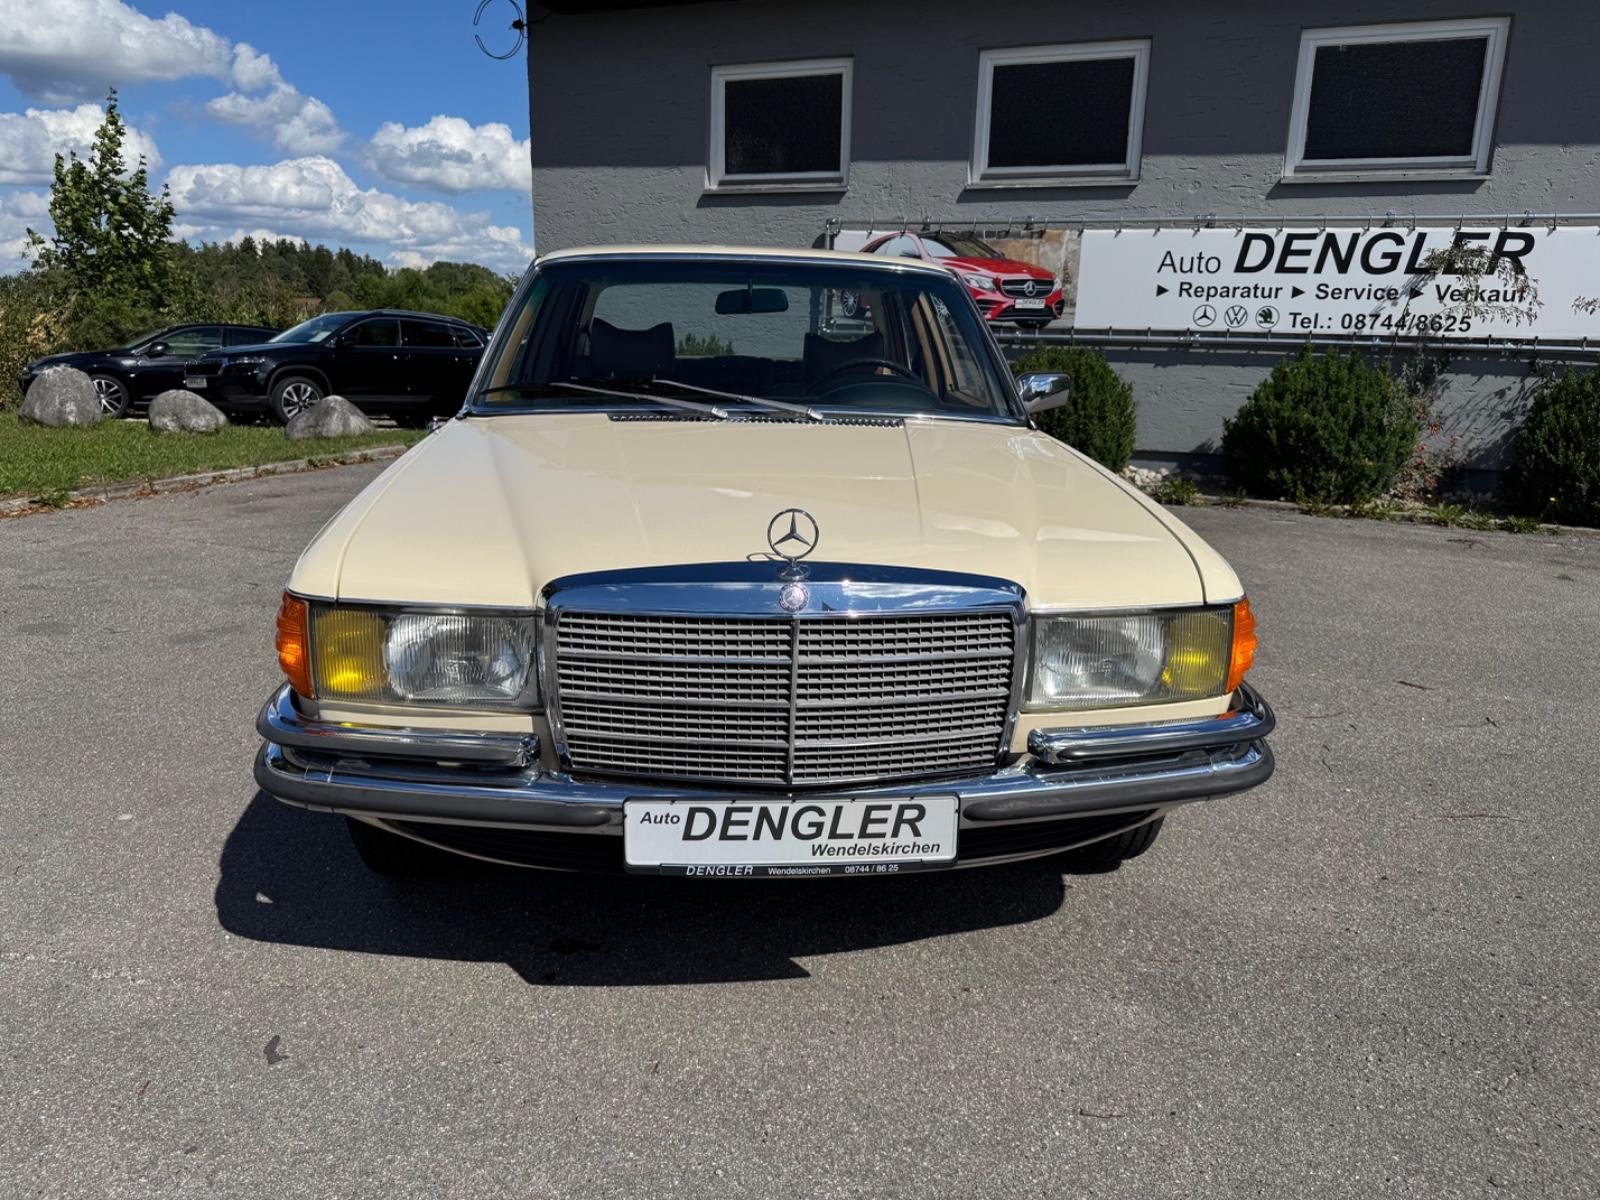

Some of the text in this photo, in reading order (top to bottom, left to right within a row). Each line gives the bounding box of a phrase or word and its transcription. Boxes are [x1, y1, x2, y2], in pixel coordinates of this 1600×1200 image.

[1156, 231, 1536, 276] Auto DENGLER
[1178, 281, 1284, 302] Reparatur
[1315, 282, 1400, 301] Service
[1288, 312, 1472, 333] Tel.: 08744/8625
[639, 803, 927, 841] Auto DENGLER
[811, 841, 941, 857] Wendelskirchen
[686, 865, 754, 876] DENGLER
[768, 866, 831, 876] Wendelskirchen
[844, 865, 870, 874] 08744
[887, 864, 899, 873] 25
